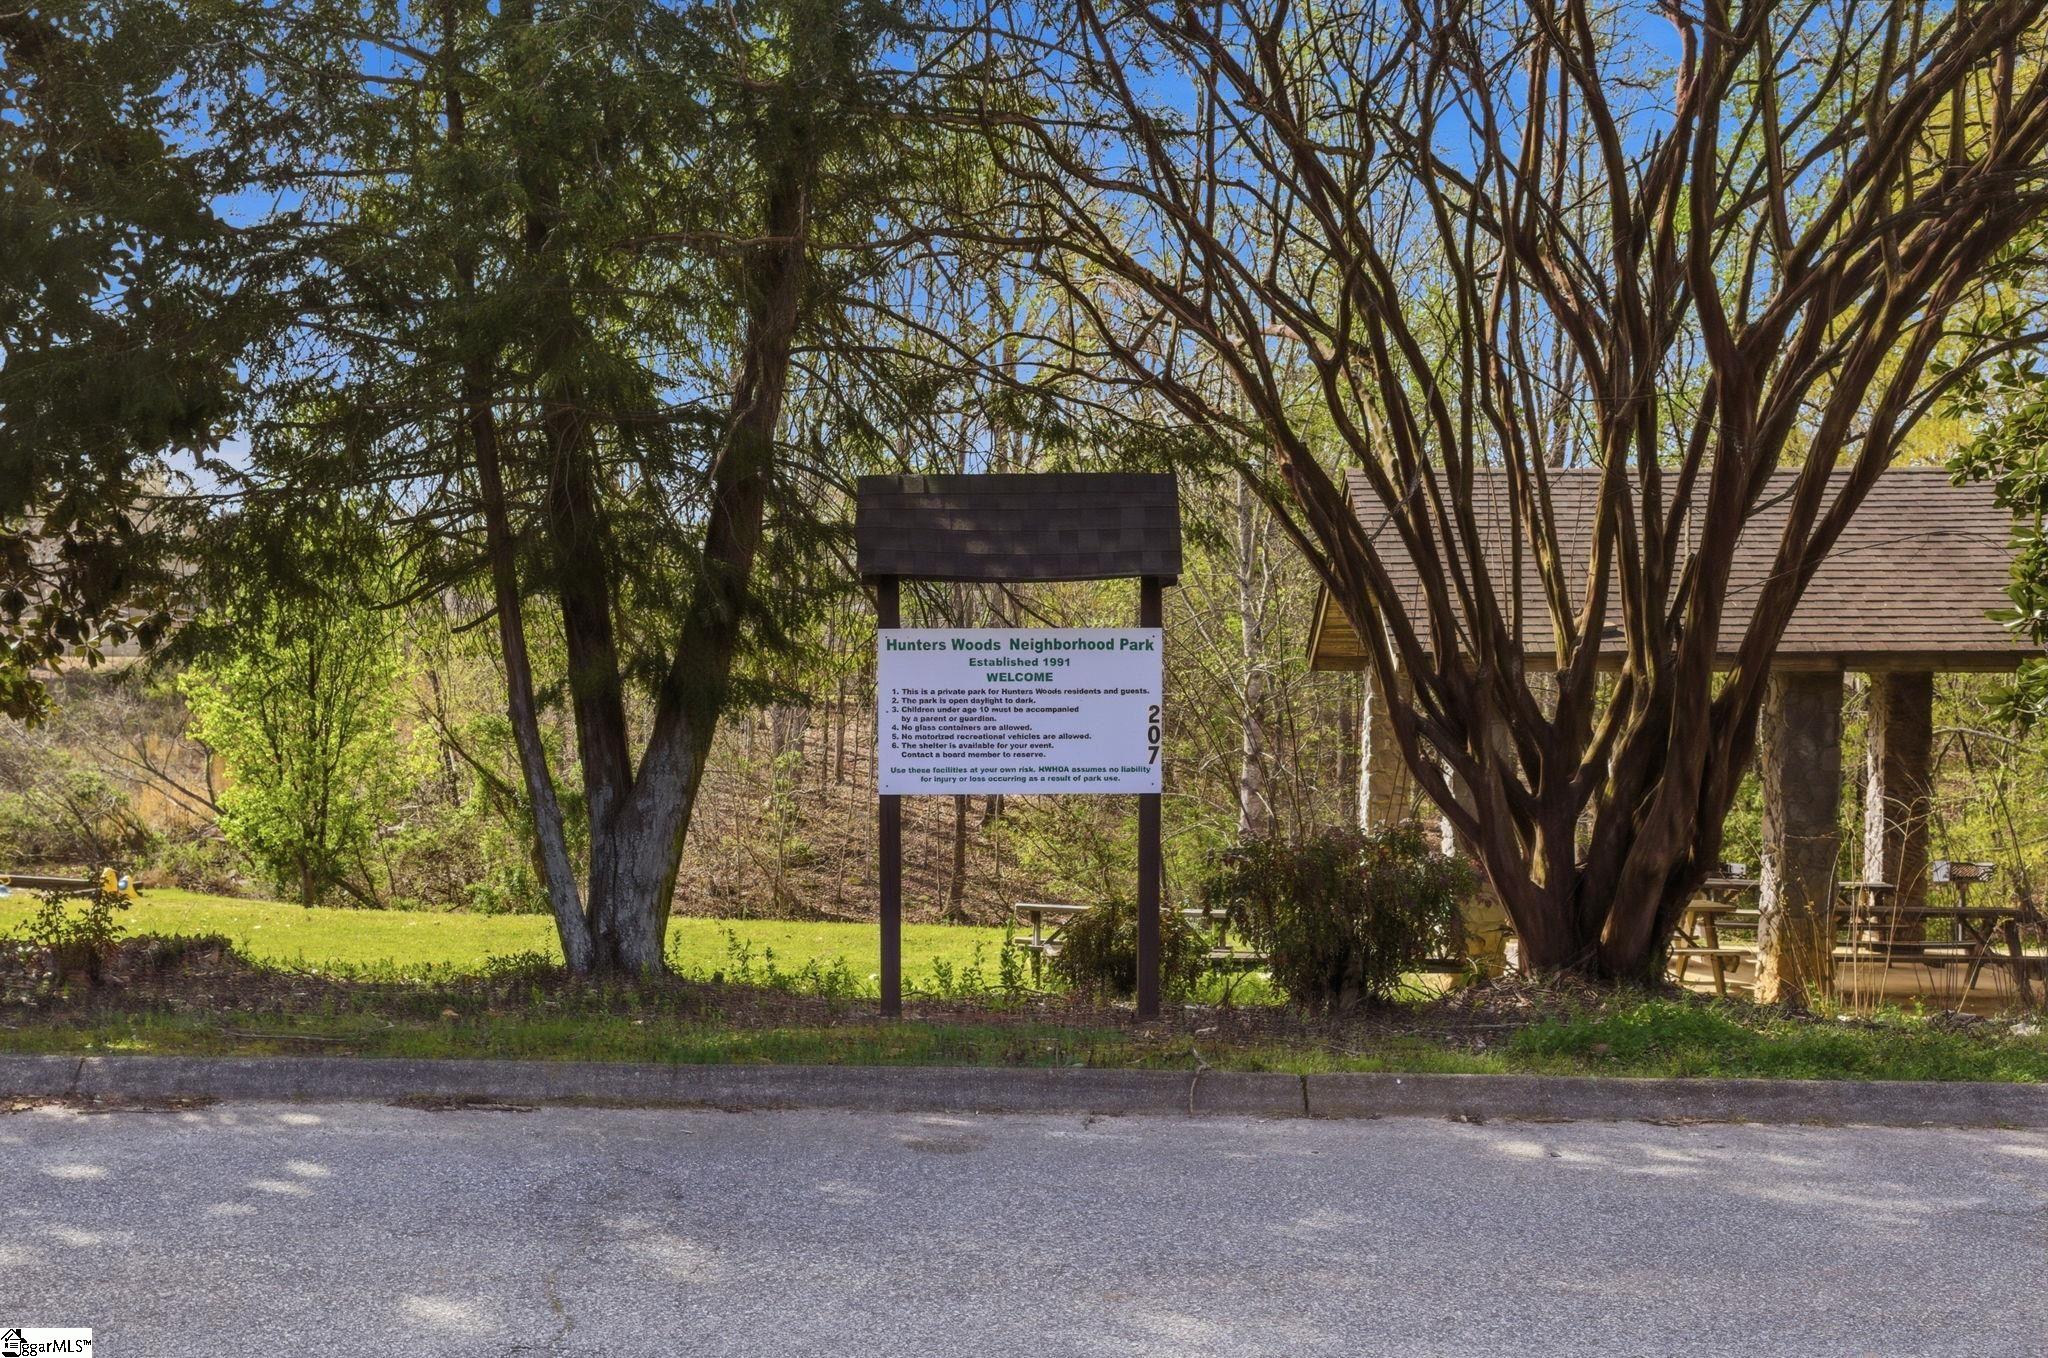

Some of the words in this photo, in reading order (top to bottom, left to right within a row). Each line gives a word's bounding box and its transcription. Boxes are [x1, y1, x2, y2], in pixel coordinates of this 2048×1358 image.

[886, 638, 946, 651] Hunters
[951, 638, 1001, 651] Woods
[1010, 637, 1114, 654] Neighborhood
[1120, 638, 1155, 651] Park
[969, 656, 1039, 667] Established
[1042, 657, 1070, 667] 1991
[986, 672, 1054, 682] WELCOME
[937, 688, 966, 696] private
[967, 688, 986, 696] park
[1120, 688, 1150, 696] guests.
[918, 697, 938, 706] park
[970, 696, 1003, 706] daylight
[1025, 706, 1079, 714] accompanied
[901, 715, 911, 724] by
[959, 715, 997, 724] guardian.
[914, 724, 936, 732] glass
[1148, 705, 1160, 764] 207
[1120, 766, 1151, 774] liability
[934, 776, 957, 784] injury
[987, 775, 1027, 784] occurring
[1083, 775, 1102, 783] park
